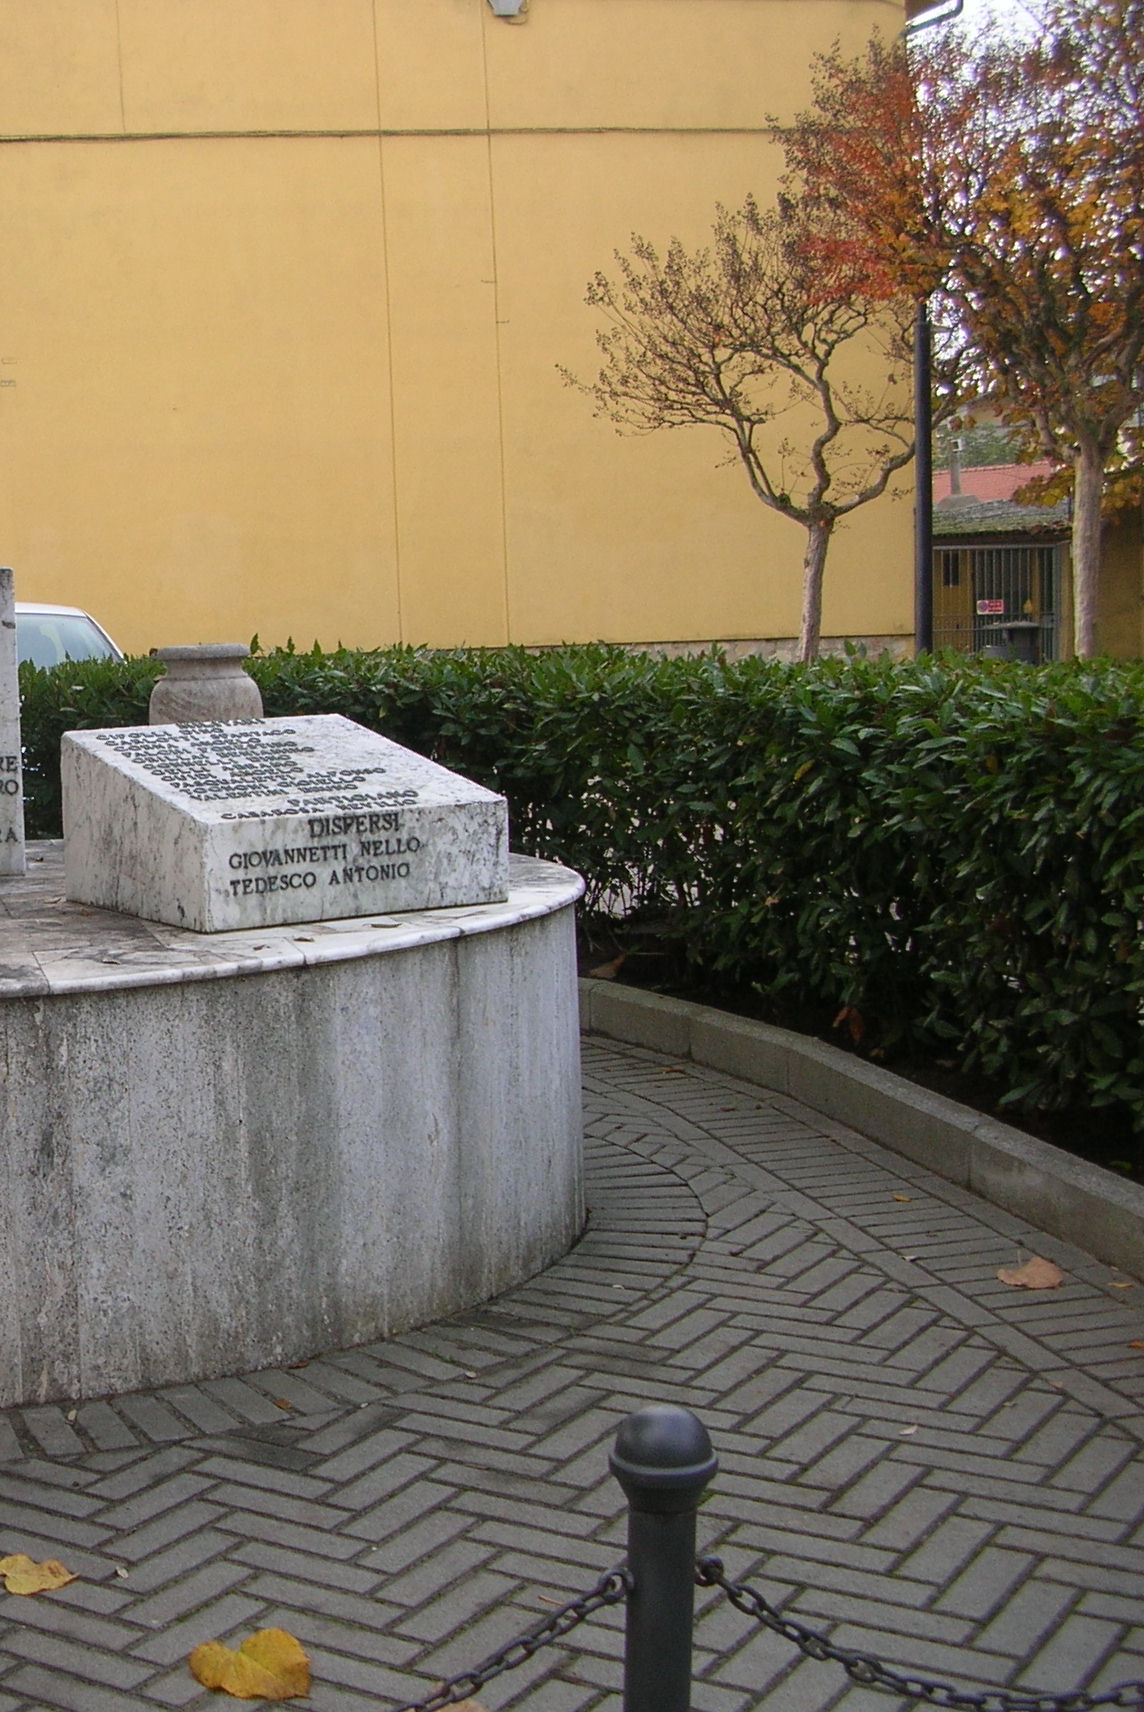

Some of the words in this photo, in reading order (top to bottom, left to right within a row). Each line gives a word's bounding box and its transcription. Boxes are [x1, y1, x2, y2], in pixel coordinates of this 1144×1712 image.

[308, 812, 401, 838] DISPERSI
[229, 844, 348, 870] GIOVANNETTI
[360, 837, 421, 857] NELLO
[230, 872, 316, 897] TEDESCO
[328, 863, 410, 886] ANTONIO
